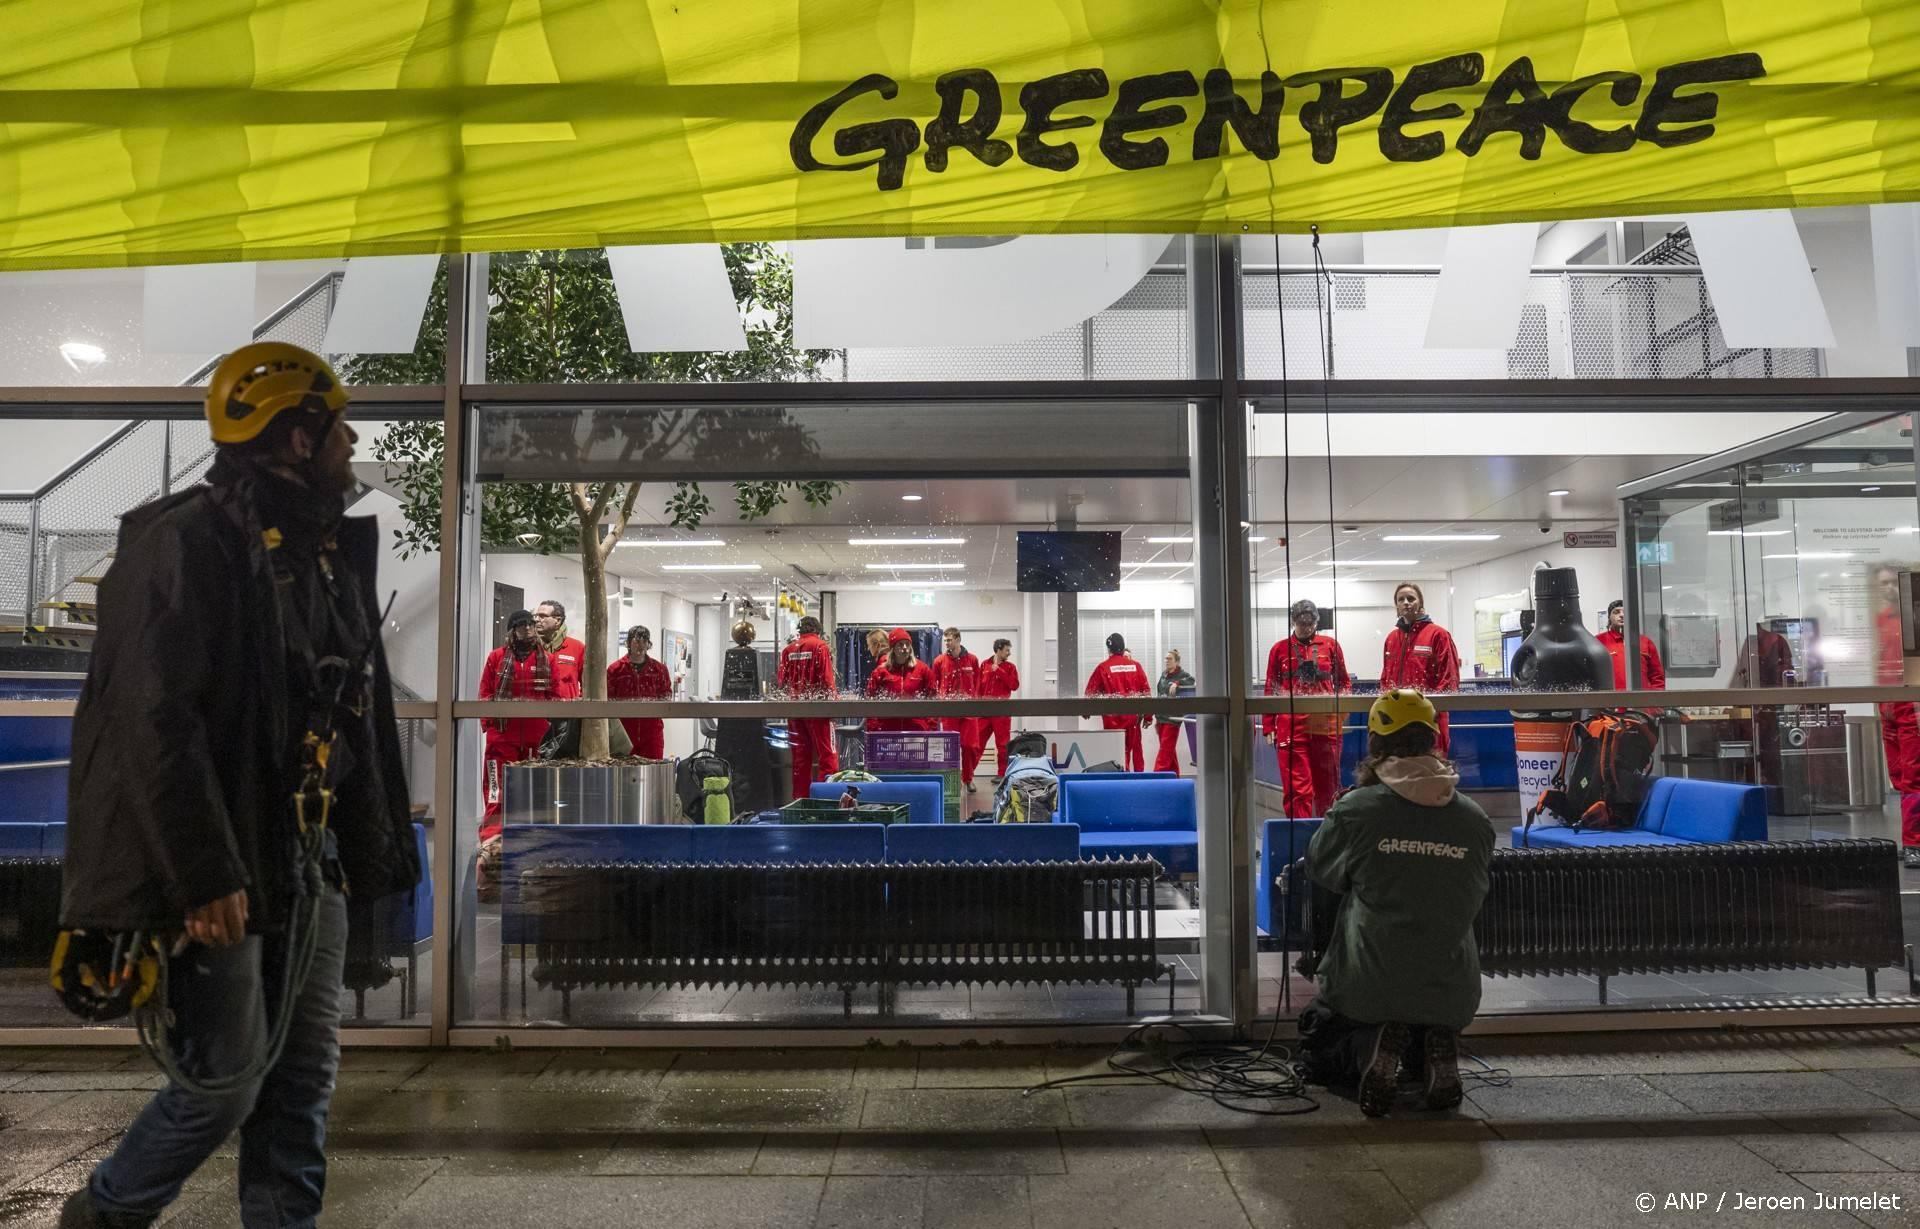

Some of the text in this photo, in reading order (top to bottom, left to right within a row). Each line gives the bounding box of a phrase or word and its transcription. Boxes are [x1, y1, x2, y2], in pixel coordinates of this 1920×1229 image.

[789, 52, 1766, 190] GREENPEACE
[1052, 742, 1086, 768] LA
[1521, 774, 1552, 789] recycl
[1378, 838, 1469, 859] GREENPEACE
